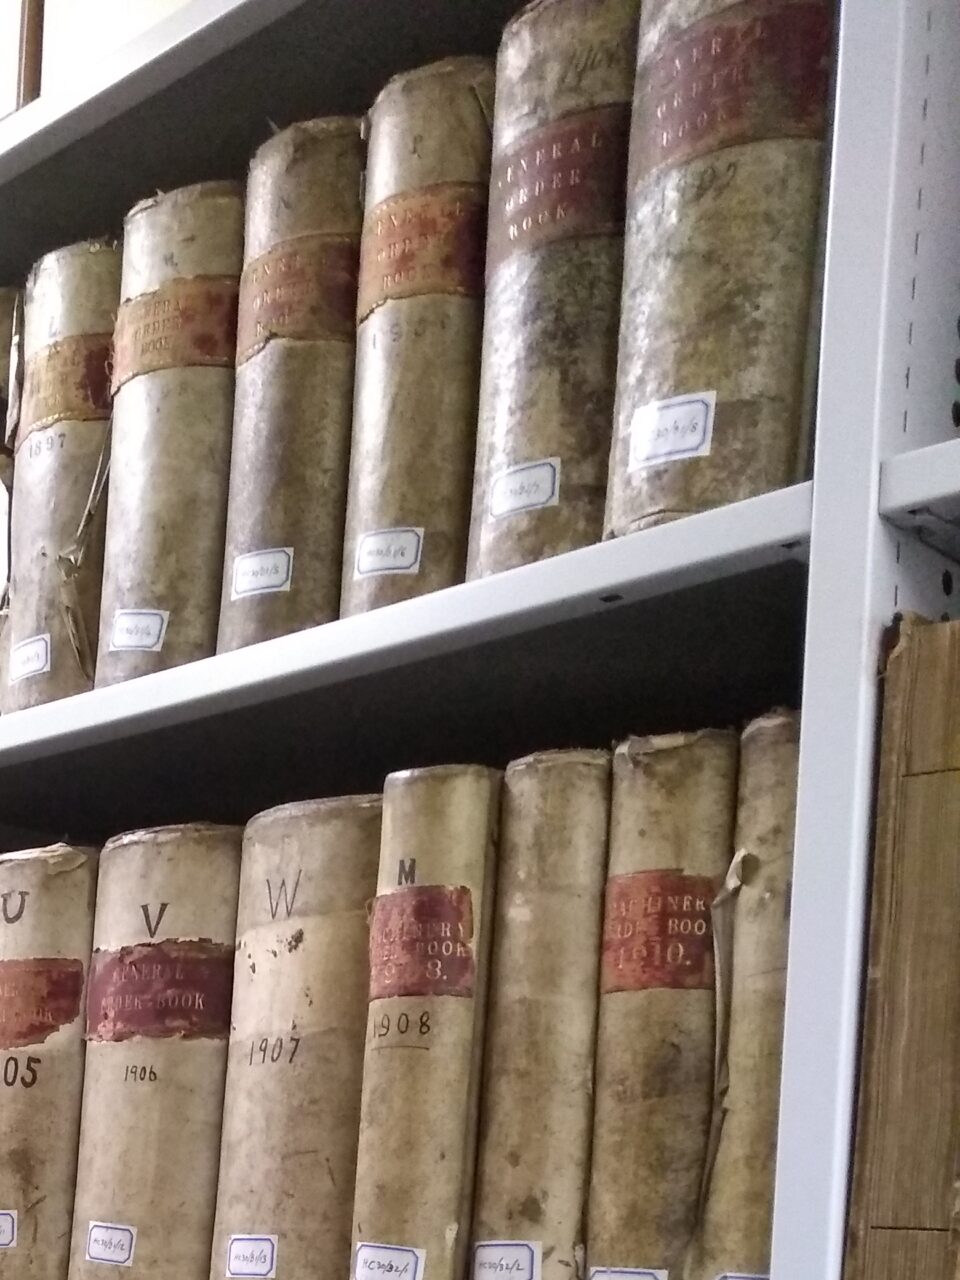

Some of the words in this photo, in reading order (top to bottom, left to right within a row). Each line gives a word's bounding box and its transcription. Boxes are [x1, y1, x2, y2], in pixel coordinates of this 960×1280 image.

[29, 433, 67, 459] 1897
[396, 857, 417, 887] M
[0, 890, 30, 924] U
[265, 868, 303, 922] W
[140, 902, 169, 939] V
[372, 1010, 432, 1039] 1908
[247, 1036, 301, 1067] 1907
[124, 1064, 158, 1083] 1906
